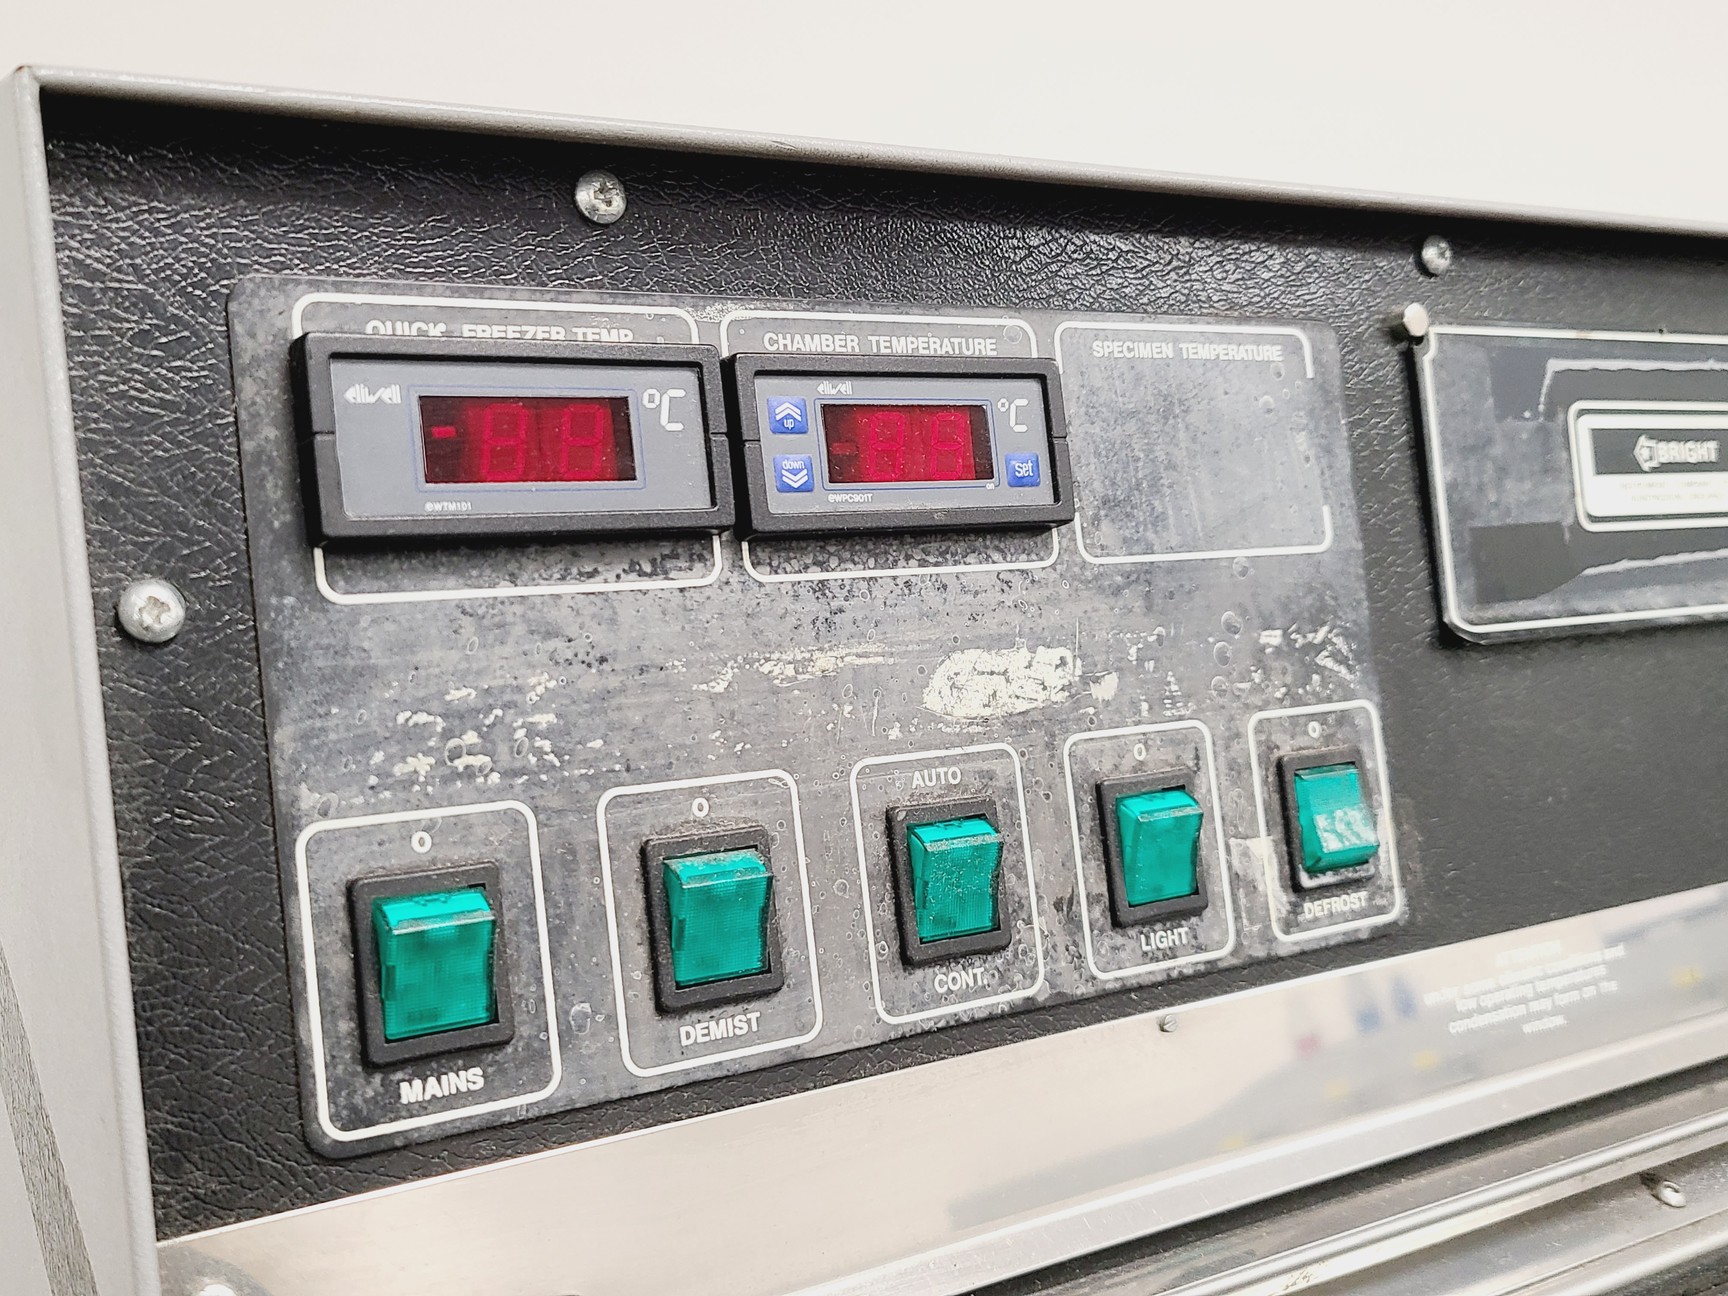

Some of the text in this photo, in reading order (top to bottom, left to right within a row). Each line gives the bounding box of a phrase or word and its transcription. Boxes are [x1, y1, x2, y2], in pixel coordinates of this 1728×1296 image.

[763, 332, 998, 356] CHAMBER TEMPERATURE
[1092, 340, 1285, 362] SPECIMEN TEMPERATURE
[783, 417, 795, 431] up
[1657, 440, 1720, 464] BRIGHT
[782, 459, 805, 470] down
[1014, 459, 1034, 478] set
[911, 766, 962, 790] AUTO
[1303, 891, 1369, 919] DEFROST
[1140, 926, 1190, 954] LIGHT
[679, 1012, 760, 1046] DEMIST
[1448, 1003, 1528, 1034] condensation
[399, 1066, 485, 1105] MAINS
